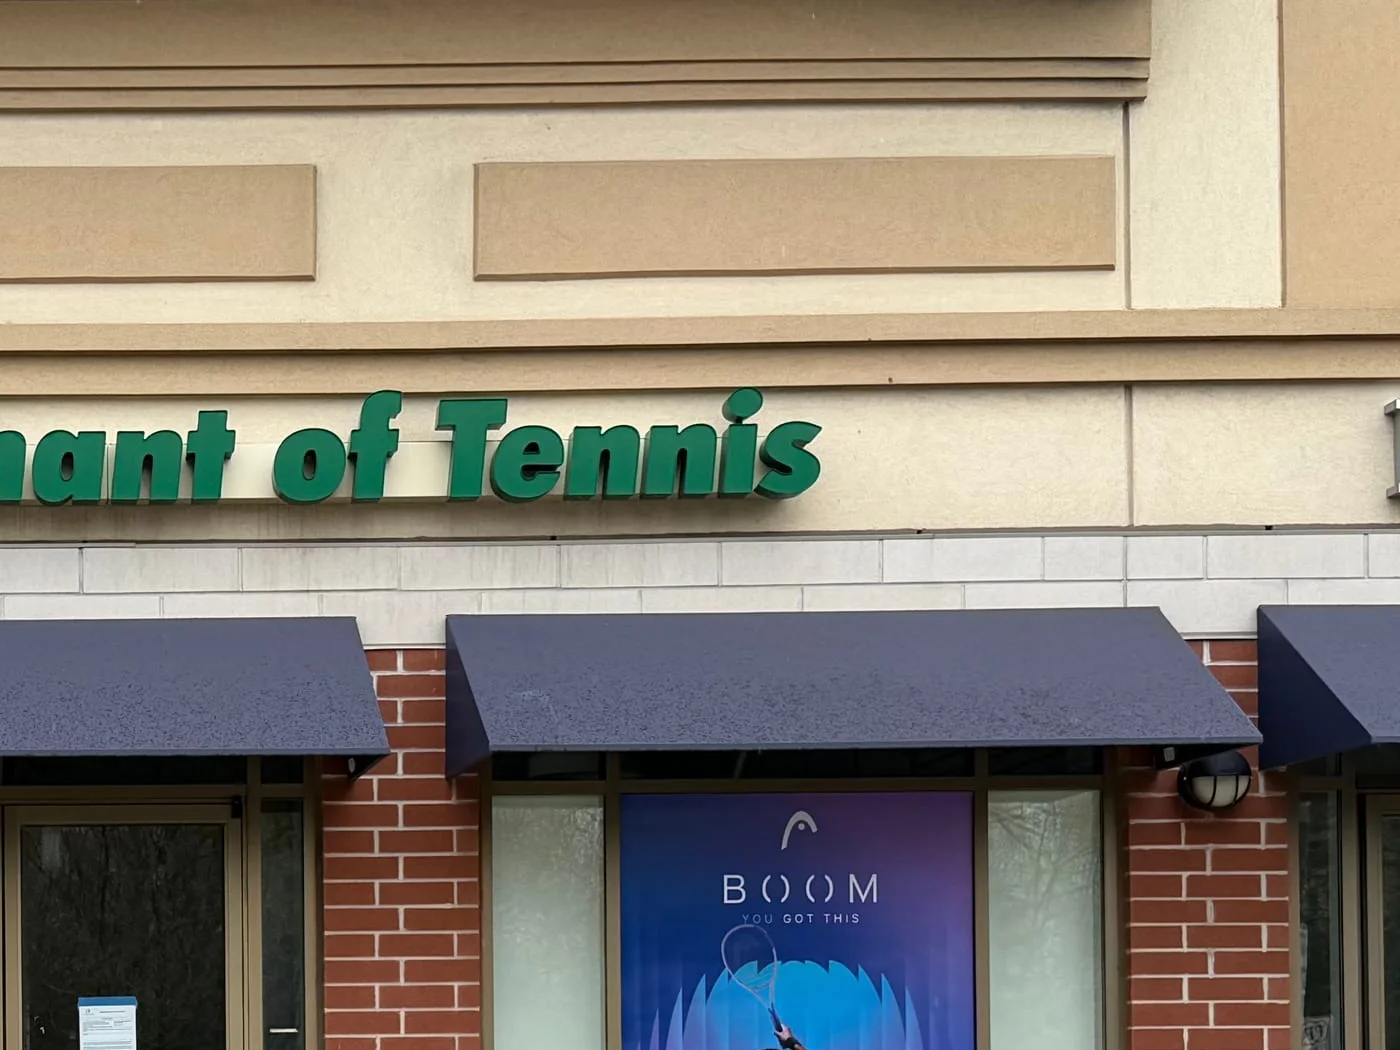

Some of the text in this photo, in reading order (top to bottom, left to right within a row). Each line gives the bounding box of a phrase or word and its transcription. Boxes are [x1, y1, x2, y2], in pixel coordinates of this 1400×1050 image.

[273, 389, 403, 504] of
[436, 387, 822, 501] Tennis
[722, 873, 879, 904] BOOM
[742, 913, 860, 925] YOU GOT THIS
